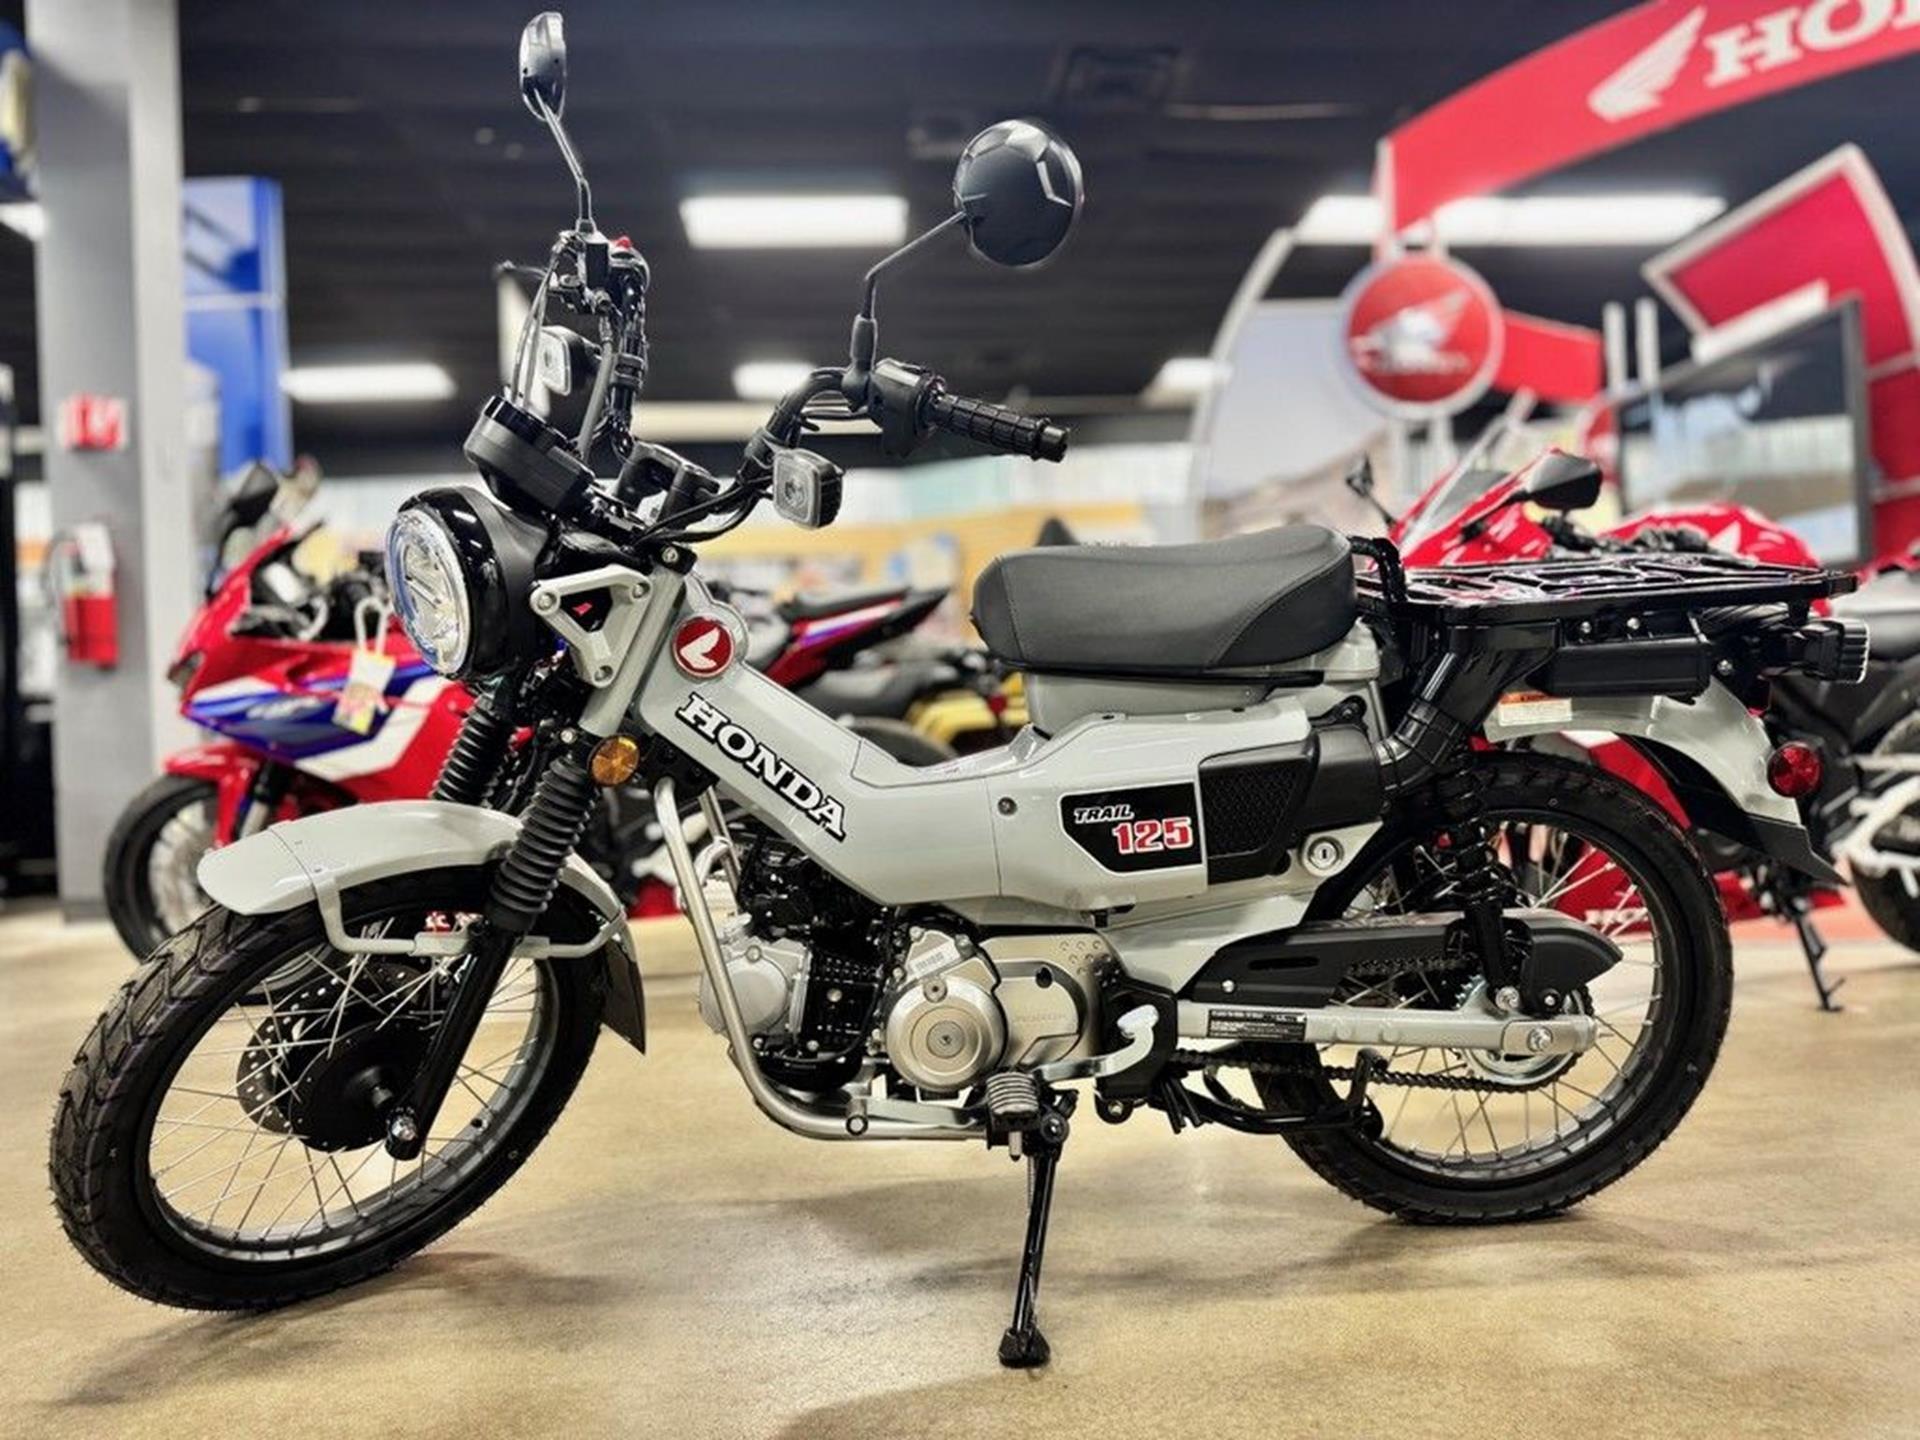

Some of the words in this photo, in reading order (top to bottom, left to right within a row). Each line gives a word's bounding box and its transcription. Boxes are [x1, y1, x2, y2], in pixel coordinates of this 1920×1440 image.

[1704, 0, 1920, 88] HO
[675, 691, 846, 842] HONDA
[1074, 804, 1135, 824] TRAIL
[1112, 816, 1194, 854] 125
